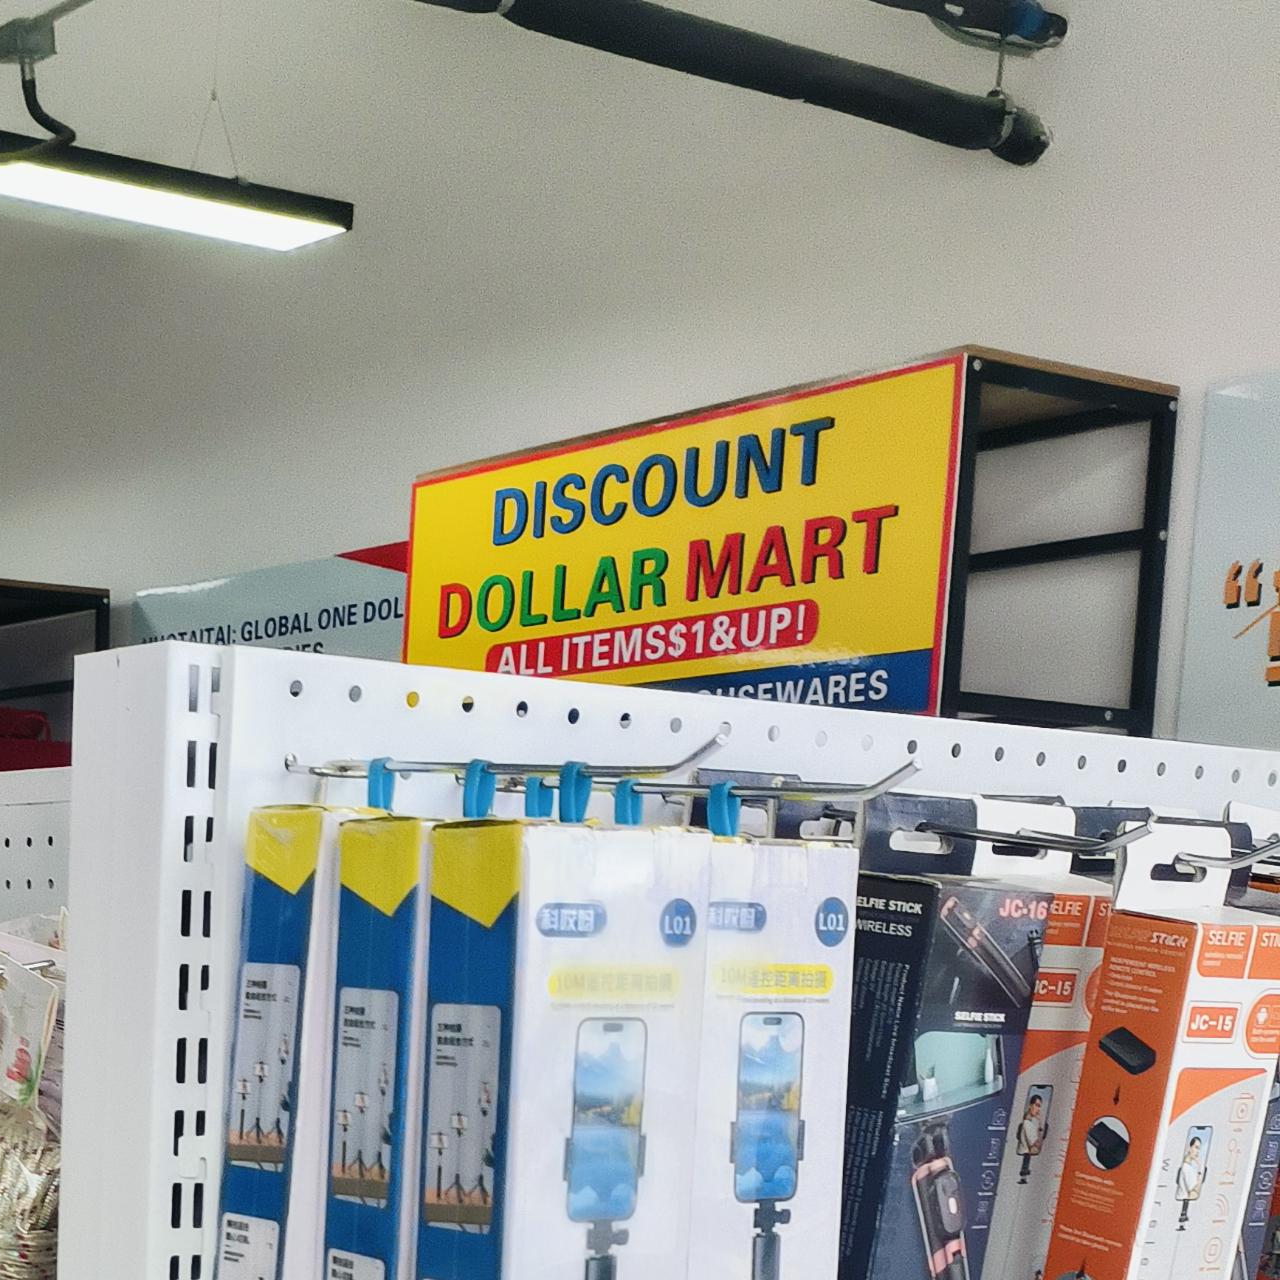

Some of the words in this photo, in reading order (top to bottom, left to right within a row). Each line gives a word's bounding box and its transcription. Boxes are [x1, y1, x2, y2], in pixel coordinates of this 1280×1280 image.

[491, 416, 836, 547] DISCOUNT
[437, 546, 670, 640] DOLLAR
[683, 503, 901, 603] MART
[241, 612, 313, 642] GLOBAL
[317, 603, 357, 631] ONE
[363, 596, 404, 625] DOL
[496, 642, 554, 676] ALL
[856, 895, 886, 910] ELFIE
[888, 898, 923, 914] STICK
[999, 898, 1049, 920] JC-16
[1050, 900, 1083, 916] ELFIE
[664, 914, 693, 936] L01
[818, 912, 845, 931] L01
[855, 918, 913, 938] WIRELESS
[1207, 930, 1246, 947] SELFIE
[954, 1010, 983, 1022] SELFIE
[983, 1012, 1006, 1023] STICK
[1190, 1014, 1233, 1031] JC-15
